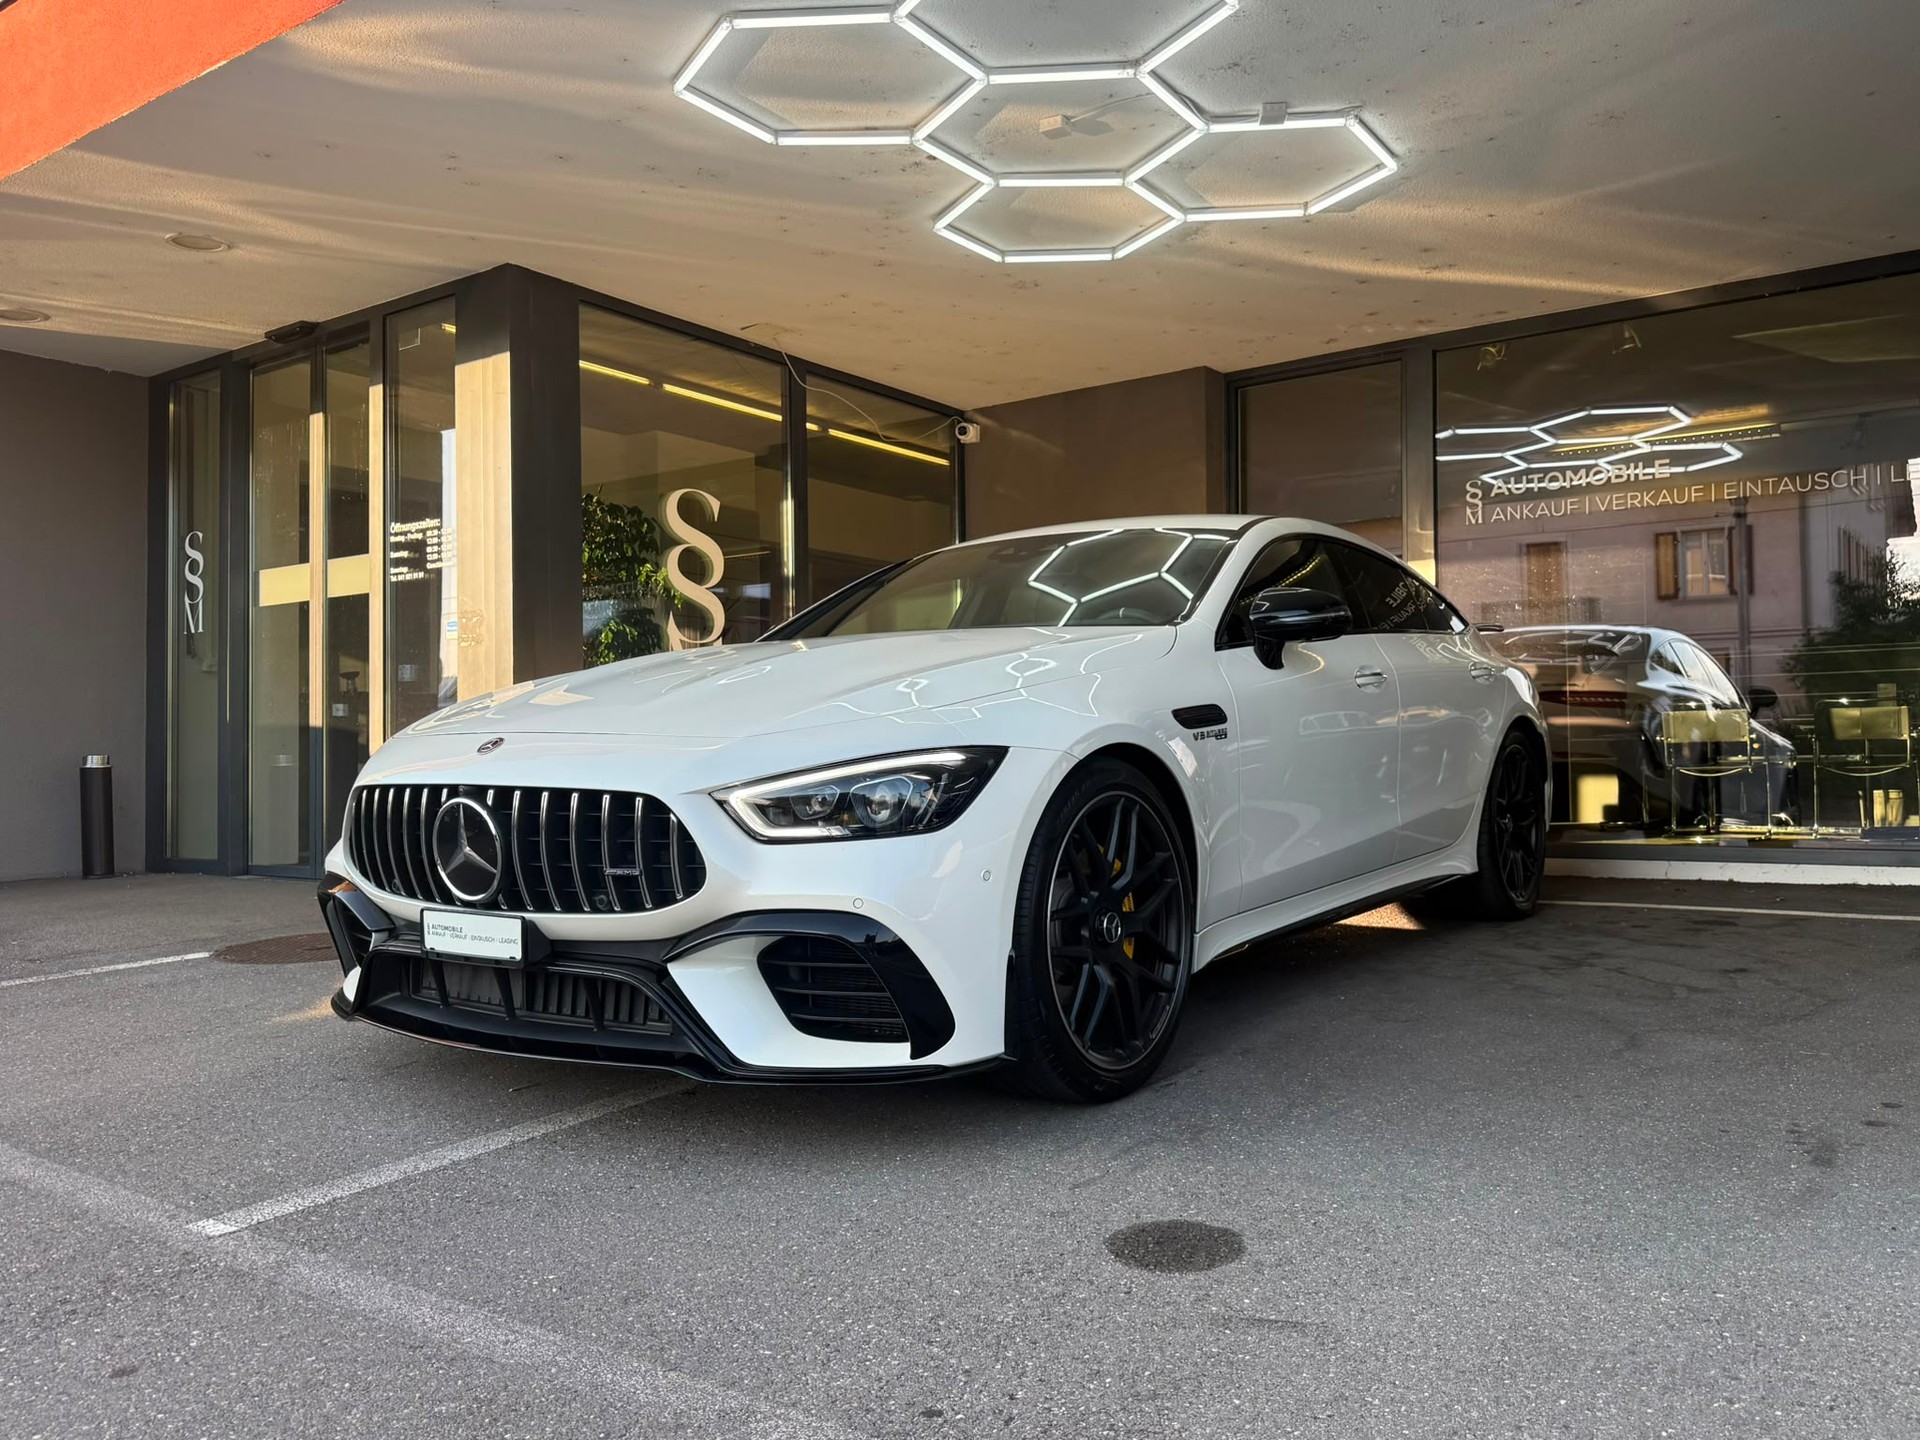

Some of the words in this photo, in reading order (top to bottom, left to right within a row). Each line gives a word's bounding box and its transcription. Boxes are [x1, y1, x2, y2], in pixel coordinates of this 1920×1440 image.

[1490, 459, 1671, 497] AUTOMOBILE
[1491, 499, 1579, 523] ANKAUF
[1596, 485, 1704, 511] VERKAUF
[1724, 467, 1866, 500] EINTAUSCH
[431, 923, 463, 933] AUTOMOBILE
